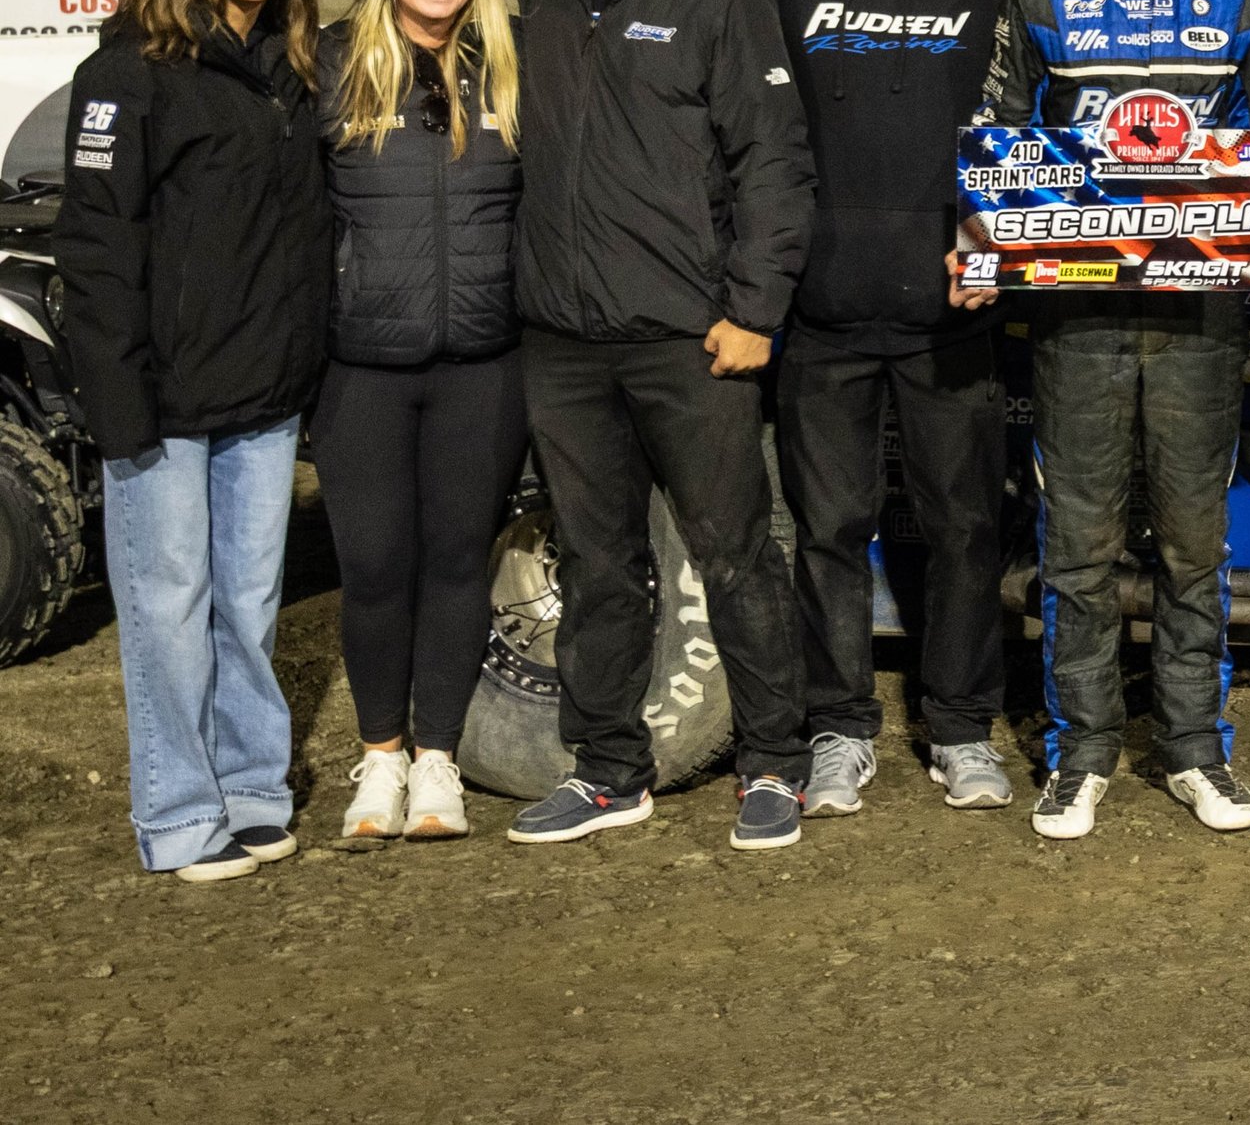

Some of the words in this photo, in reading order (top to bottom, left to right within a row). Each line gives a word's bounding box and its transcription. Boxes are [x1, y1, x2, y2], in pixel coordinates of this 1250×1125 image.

[804, 2, 972, 38] RUDEEN
[1188, 31, 1222, 43] BELL
[82, 102, 118, 131] 26
[1118, 103, 1181, 128] HILL'S
[75, 150, 113, 163] RUDEEN
[1010, 142, 1042, 163] 410
[1117, 145, 1153, 157] PREMIUM
[1155, 145, 1180, 157] MEATS
[966, 167, 1034, 189] SPRINT
[1035, 166, 1084, 186] CARS
[994, 205, 1178, 242] SECOND
[963, 252, 1001, 279] 26
[1060, 266, 1074, 277] LES
[1075, 266, 1114, 278] SCHWAB
[1145, 260, 1249, 277] SKAGIT
[1140, 277, 1241, 287] SPEEDWAY
